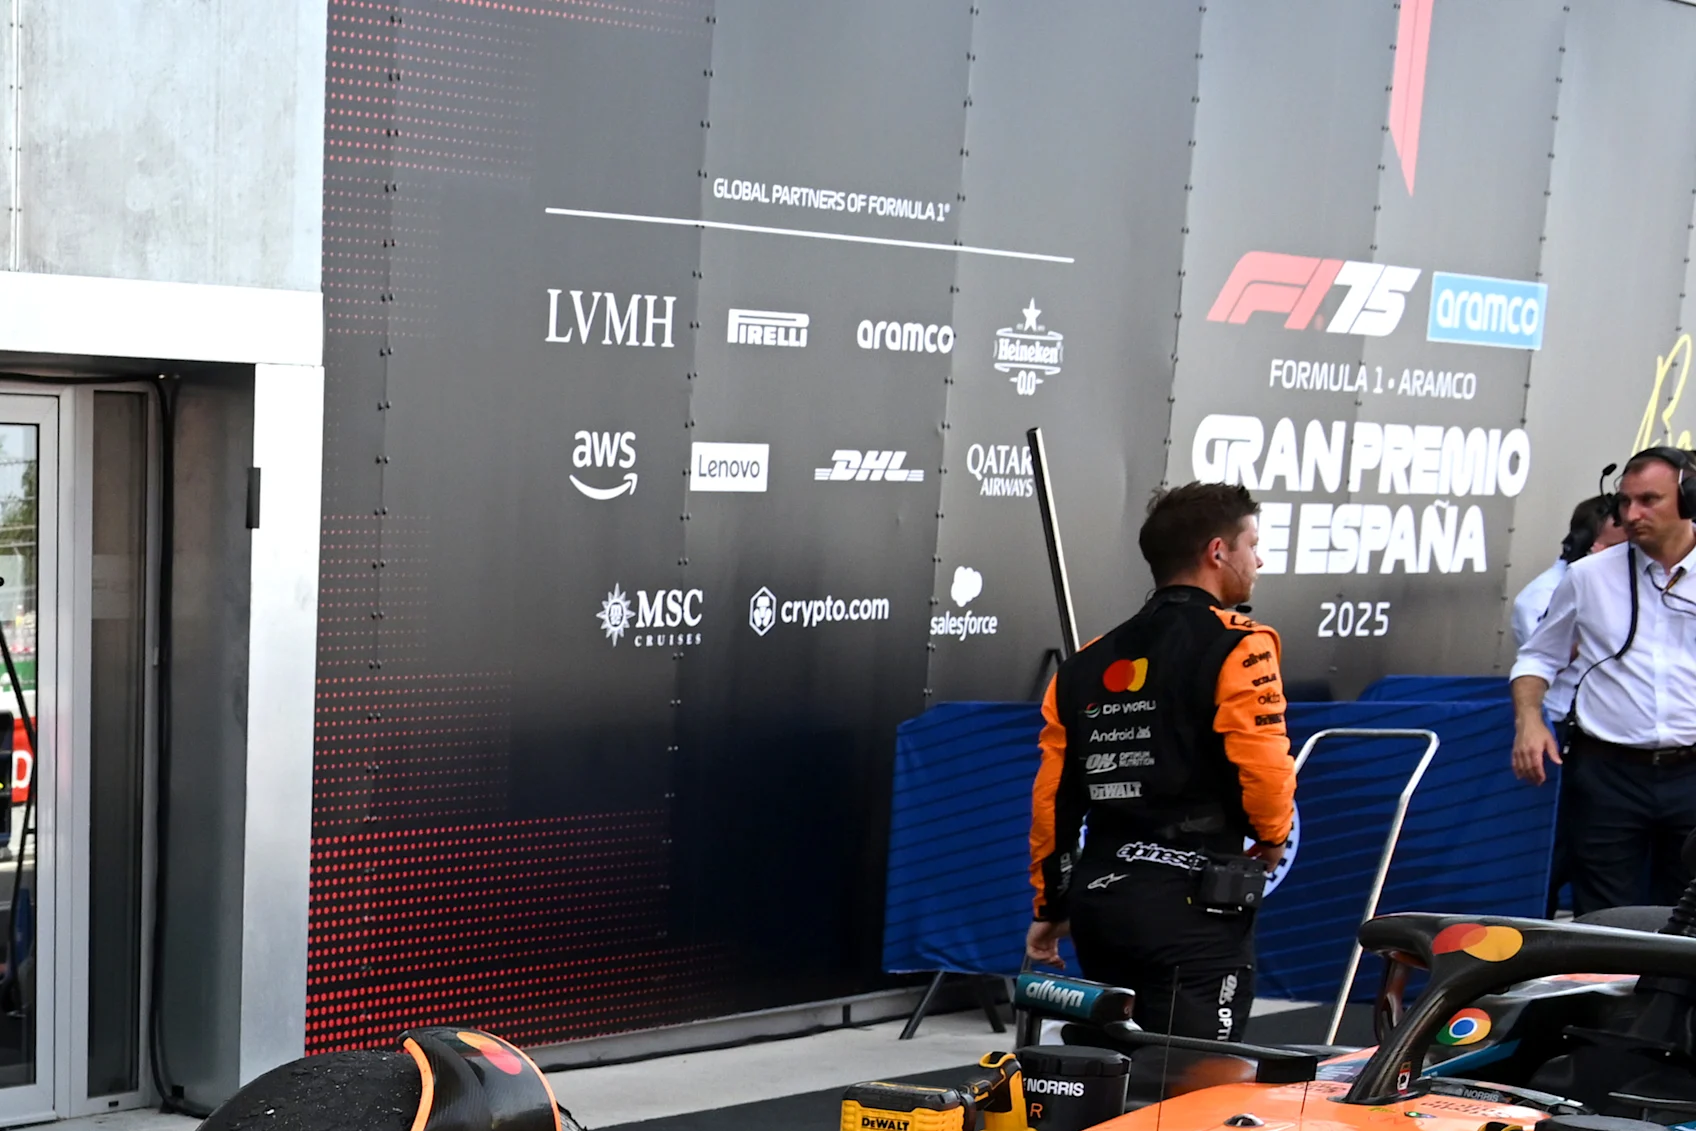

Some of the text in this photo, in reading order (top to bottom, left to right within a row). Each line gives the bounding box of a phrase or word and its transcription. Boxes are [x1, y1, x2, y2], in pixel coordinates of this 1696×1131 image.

[713, 178, 770, 203] GLOBAL
[772, 185, 845, 211] PARTNERS
[847, 193, 867, 213] OF
[869, 196, 935, 221] FORMULA
[545, 288, 677, 348] LVMH
[727, 308, 810, 347] PIRELLI
[1436, 286, 1539, 337] aramco
[857, 319, 954, 354] aramco
[998, 338, 1059, 364] Heineken
[1269, 359, 1476, 400] FORMULA 1 ARAMCO
[573, 430, 636, 469] aws
[698, 453, 761, 479] Lenovo
[830, 449, 909, 482] DHL
[966, 443, 1034, 481] QATAR
[1192, 414, 1530, 497] GRAN PREMIO
[980, 477, 1033, 498] AIRWAYS
[1295, 500, 1487, 574] ESPAÑA
[635, 588, 703, 628] MSC
[780, 595, 890, 625] crypto.com
[1317, 601, 1389, 638] 2025
[634, 633, 702, 647] CRUISES
[930, 611, 998, 642] salesforce
[1103, 703, 1121, 715] DP
[1089, 727, 1135, 742] Android
[1026, 980, 1084, 1010] allwyn
[1217, 1007, 1233, 1041] OPTI
[1026, 1078, 1085, 1097] NORRIS
[1464, 1088, 1500, 1103] NORRIS
[1029, 1103, 1043, 1118] R
